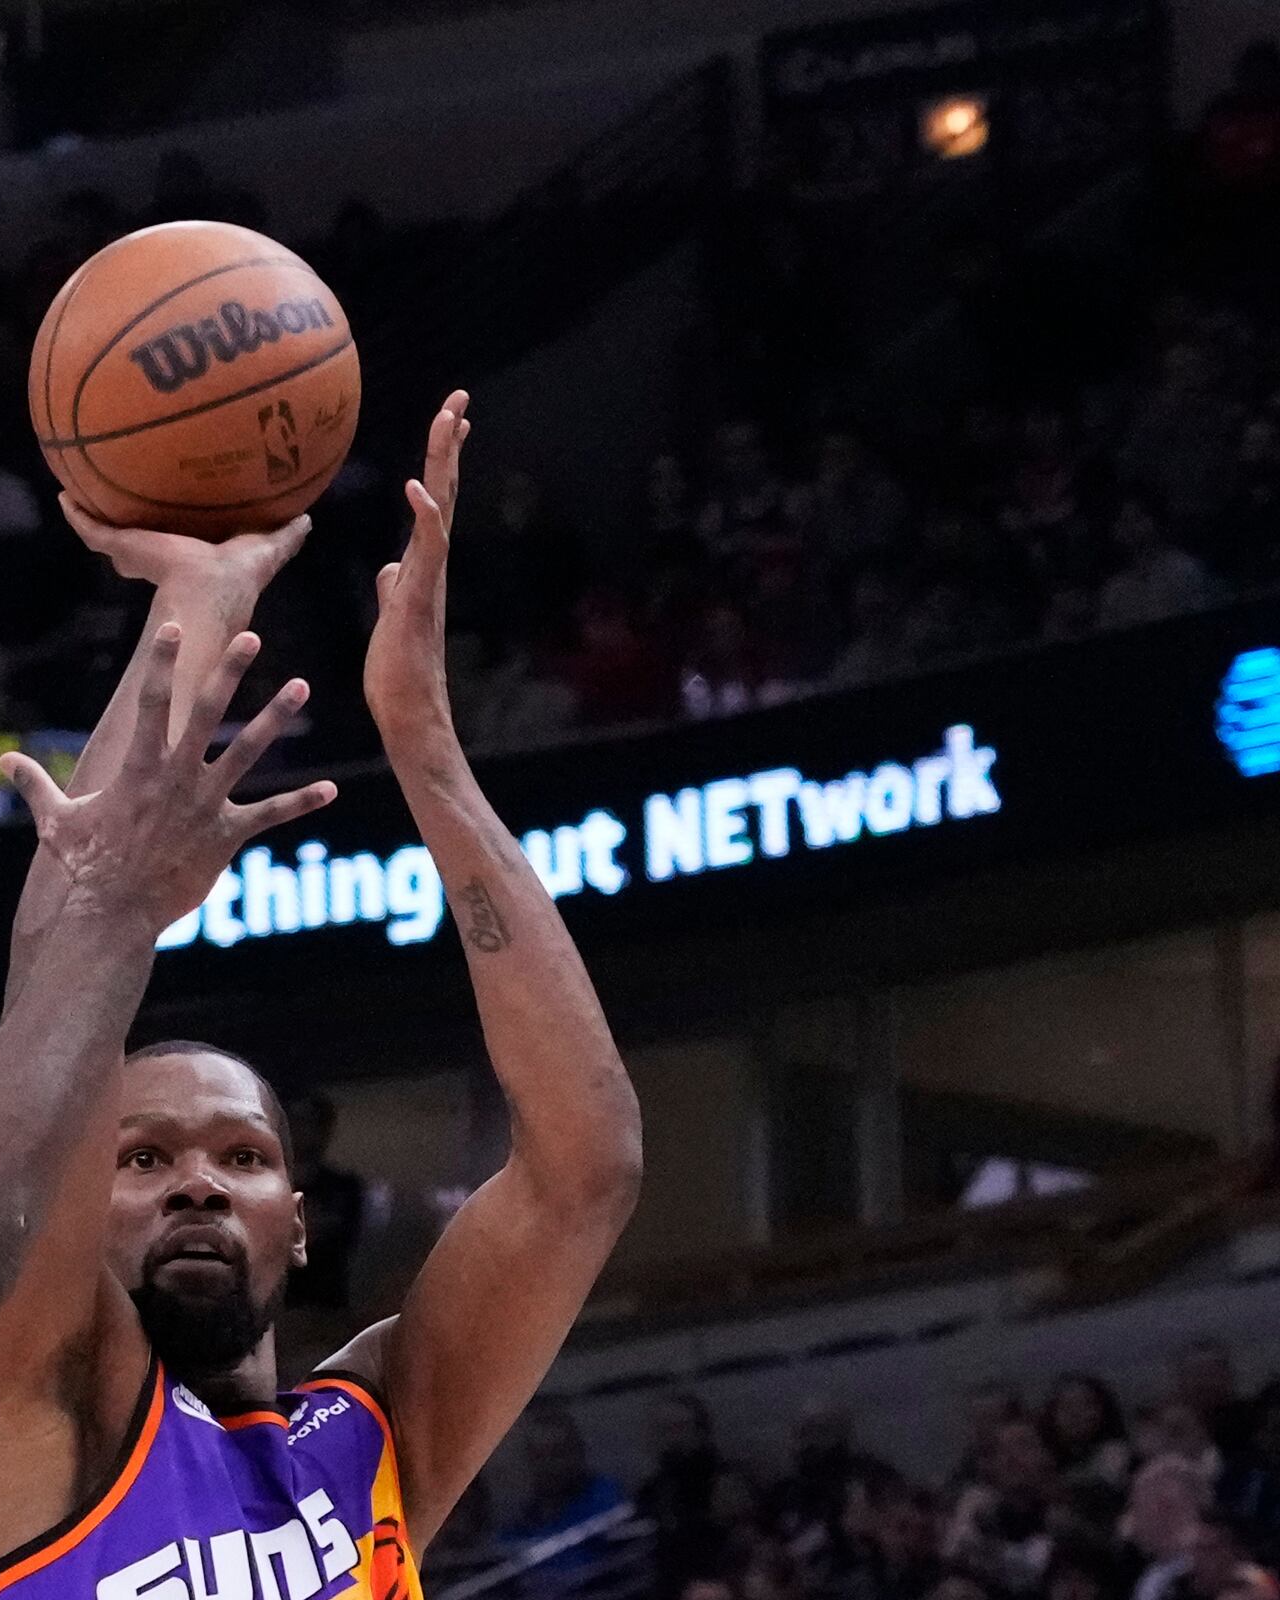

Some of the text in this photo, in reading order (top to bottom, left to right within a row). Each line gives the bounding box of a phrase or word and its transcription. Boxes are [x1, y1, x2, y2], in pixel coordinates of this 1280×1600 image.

[131, 299, 336, 392] Wilson
[155, 723, 1001, 950] thing ut NETwork
